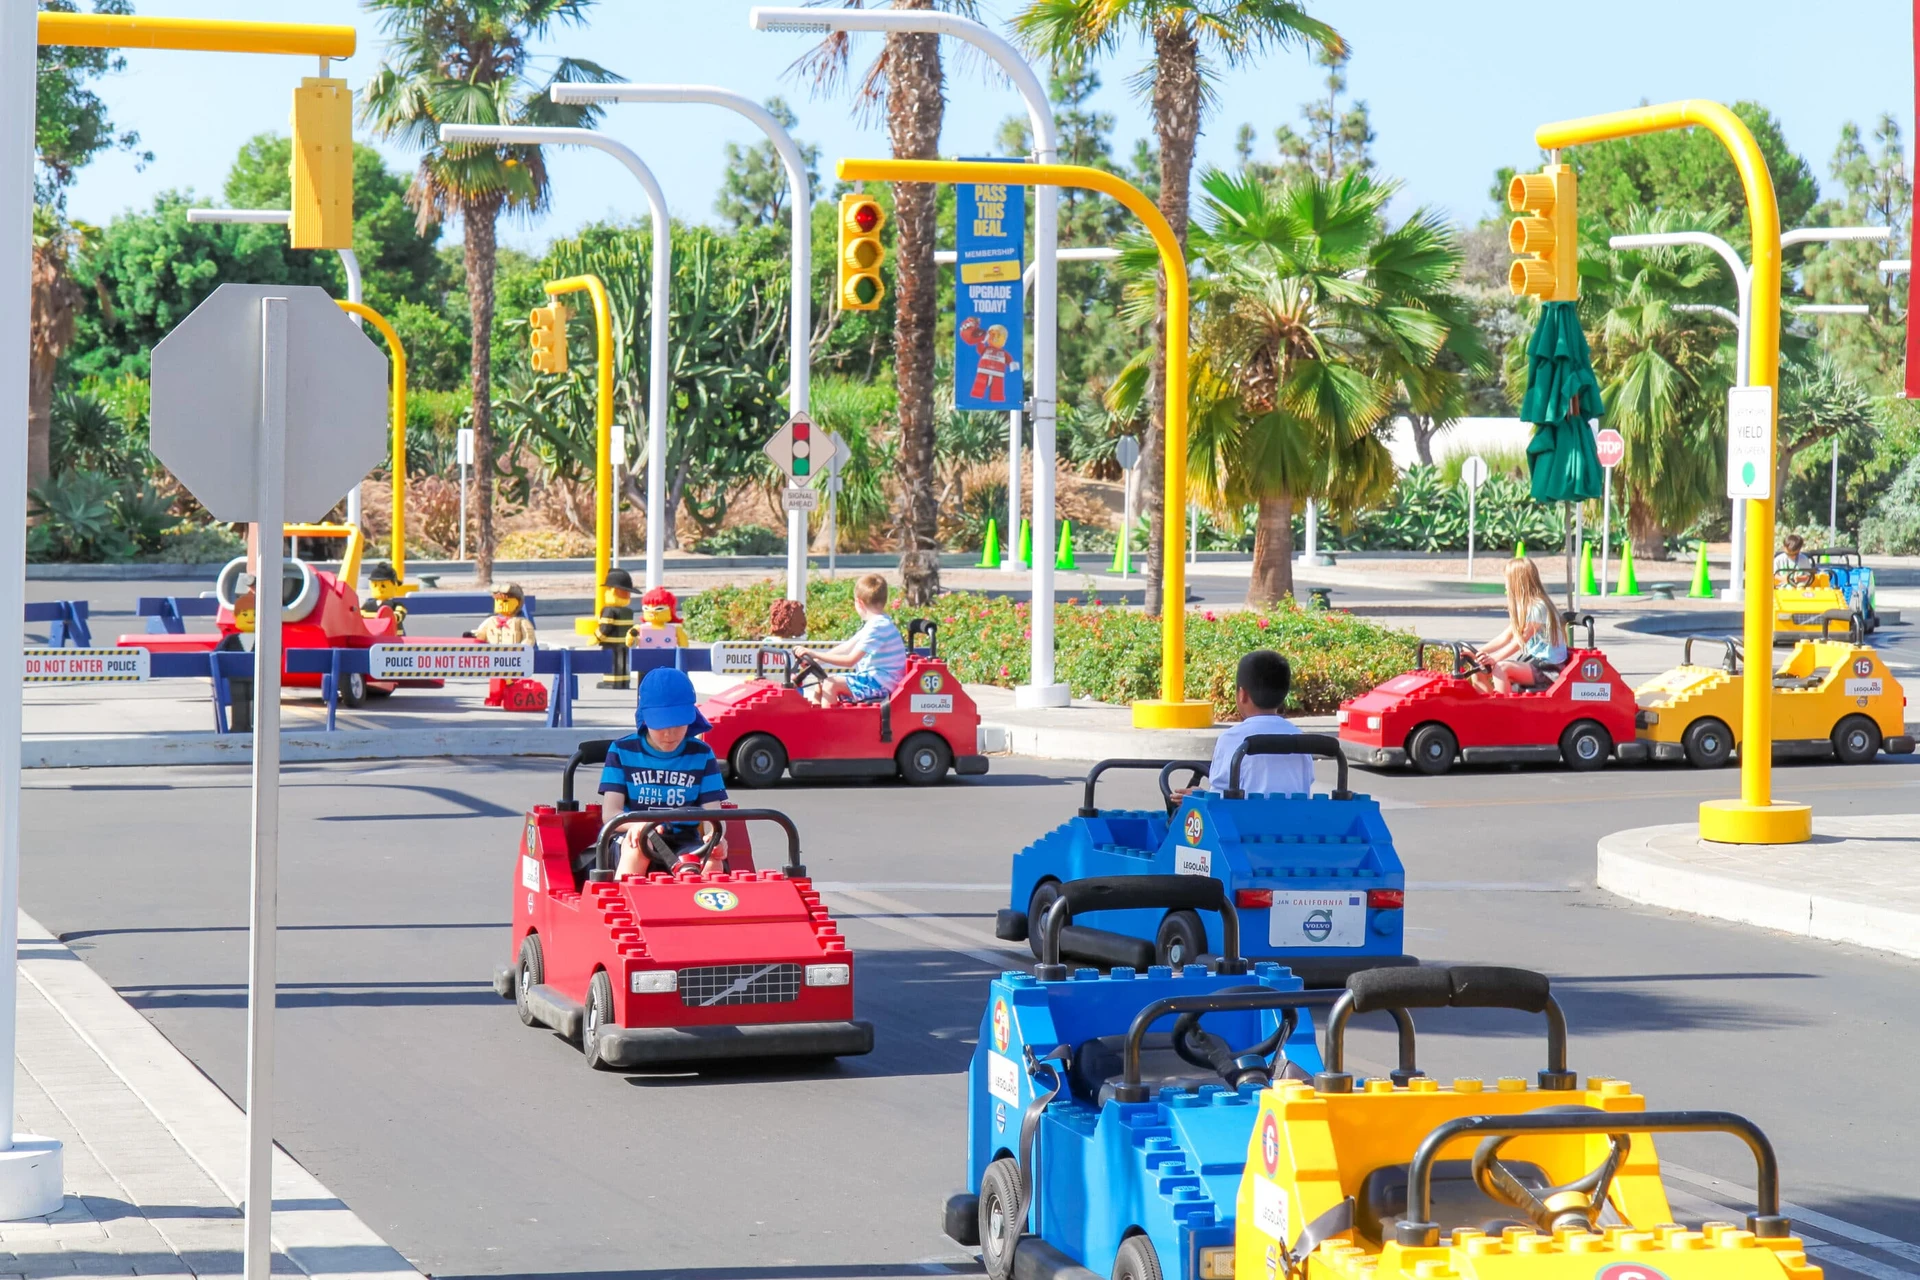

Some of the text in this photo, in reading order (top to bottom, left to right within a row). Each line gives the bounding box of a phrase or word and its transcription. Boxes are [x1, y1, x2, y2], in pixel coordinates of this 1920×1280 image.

[975, 184, 1007, 202] PASS
[976, 202, 1005, 219] THIS
[973, 219, 1007, 237] DEAL.
[964, 247, 1015, 258] MEMBERSHIP
[969, 285, 1012, 299] UPGRADE
[973, 299, 1007, 313] TODAY!
[1737, 425, 1763, 439] YIELD
[1597, 441, 1621, 454] STOP
[788, 492, 813, 500] SIGNAL
[789, 500, 813, 508] AHEAD
[385, 655, 521, 669] POLICE DO NOT ENTER POLICE
[726, 654, 752, 664] POLICE
[26, 660, 137, 673] DO NOT ENTER POLICE
[1585, 663, 1598, 677] 11
[1855, 661, 1870, 674] 15
[924, 675, 939, 689] 36
[513, 692, 546, 707] GAS
[631, 770, 696, 788] HILFIGER
[639, 787, 662, 796] ATHL
[666, 788, 686, 806] 85
[637, 796, 662, 806] DEPT
[1187, 817, 1201, 838] 29
[1183, 861, 1210, 873] LEGOLAND
[700, 892, 732, 907] 38
[1266, 1124, 1275, 1164] 6
